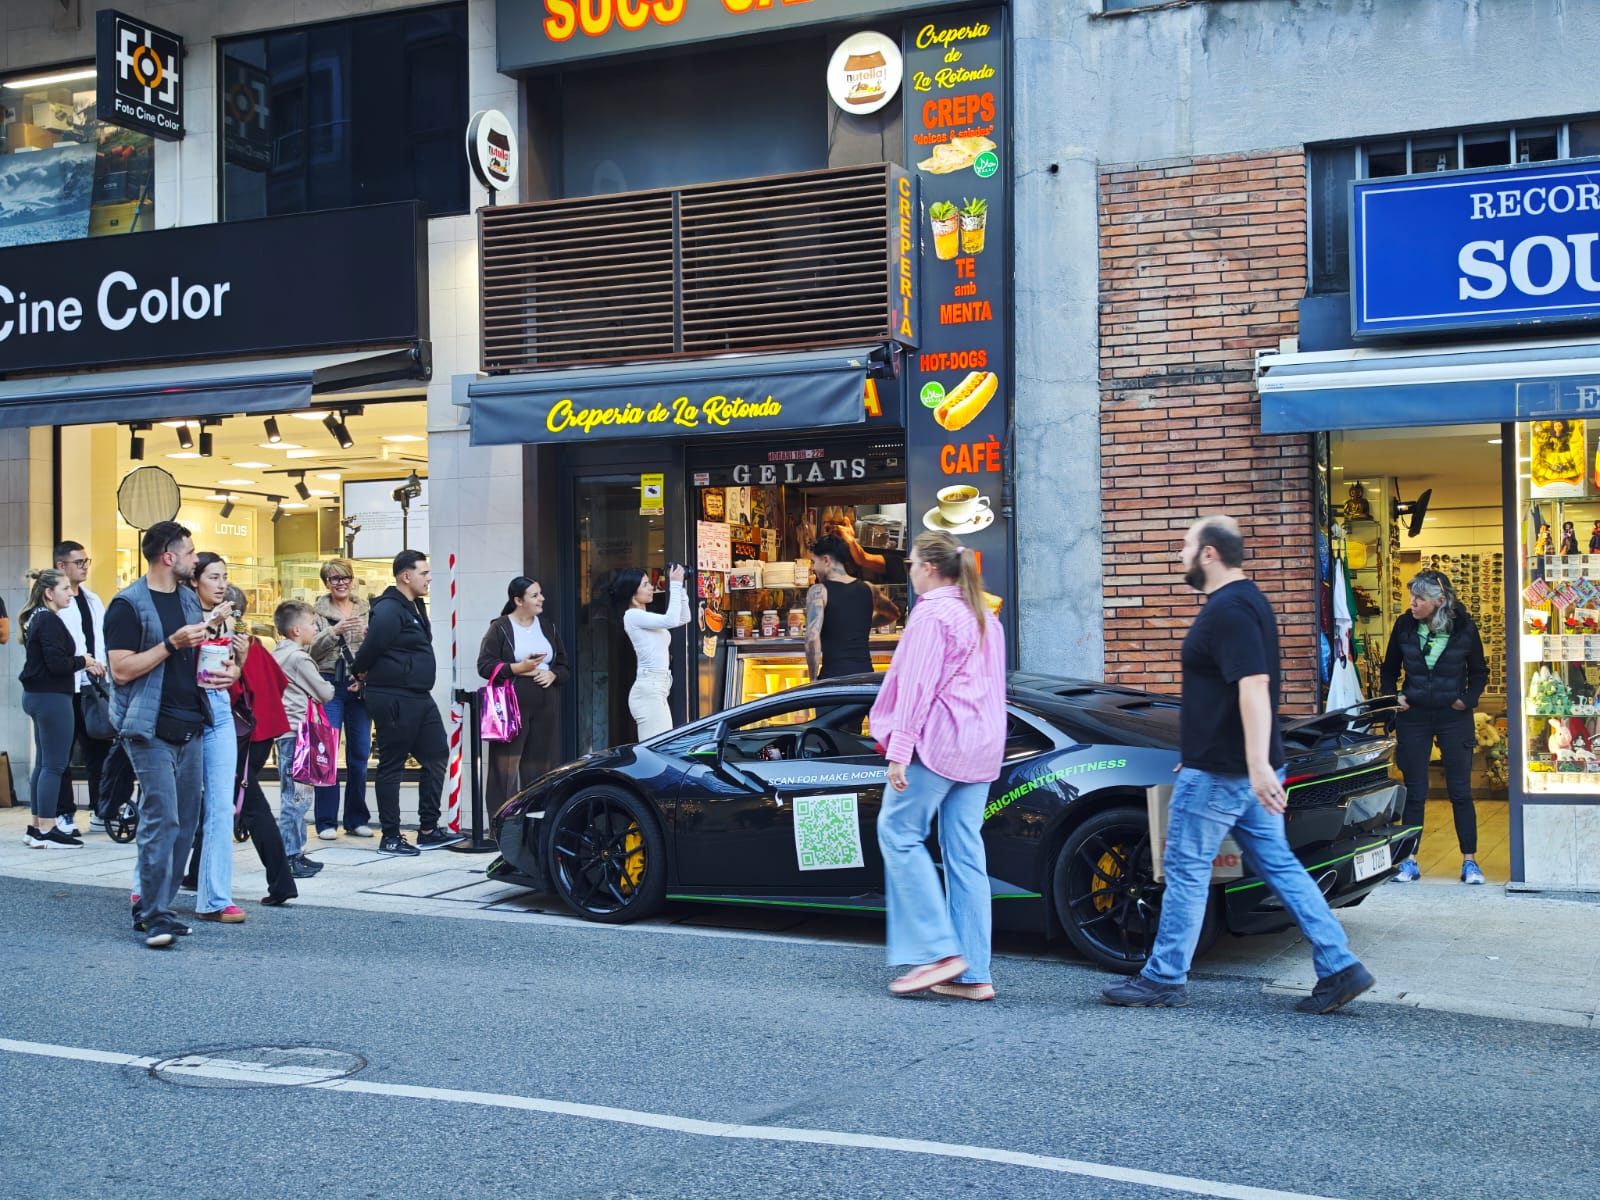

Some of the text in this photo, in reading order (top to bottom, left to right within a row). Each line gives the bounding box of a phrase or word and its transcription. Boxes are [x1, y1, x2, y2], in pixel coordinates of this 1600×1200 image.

[915, 22, 990, 49] Creperia
[944, 47, 962, 63] de
[912, 64, 995, 91] La Rotonda
[115, 99, 180, 131] Foto Cine Color
[922, 91, 995, 129] CREPS
[1470, 183, 1600, 220] RECOR
[897, 177, 913, 338] CREPERIA
[955, 257, 976, 279] TE
[954, 281, 977, 297] amb
[0, 270, 231, 342] Cine Color
[939, 300, 993, 325] MENTA
[920, 349, 987, 373] HOT-DOGS
[546, 395, 783, 433] Creperia de La Rotonda
[940, 434, 1001, 475] CAFÈ
[733, 458, 866, 485] GELATS
[215, 522, 247, 537] LOTUS
[768, 769, 890, 786] SCAN FOR MAKE MONEY
